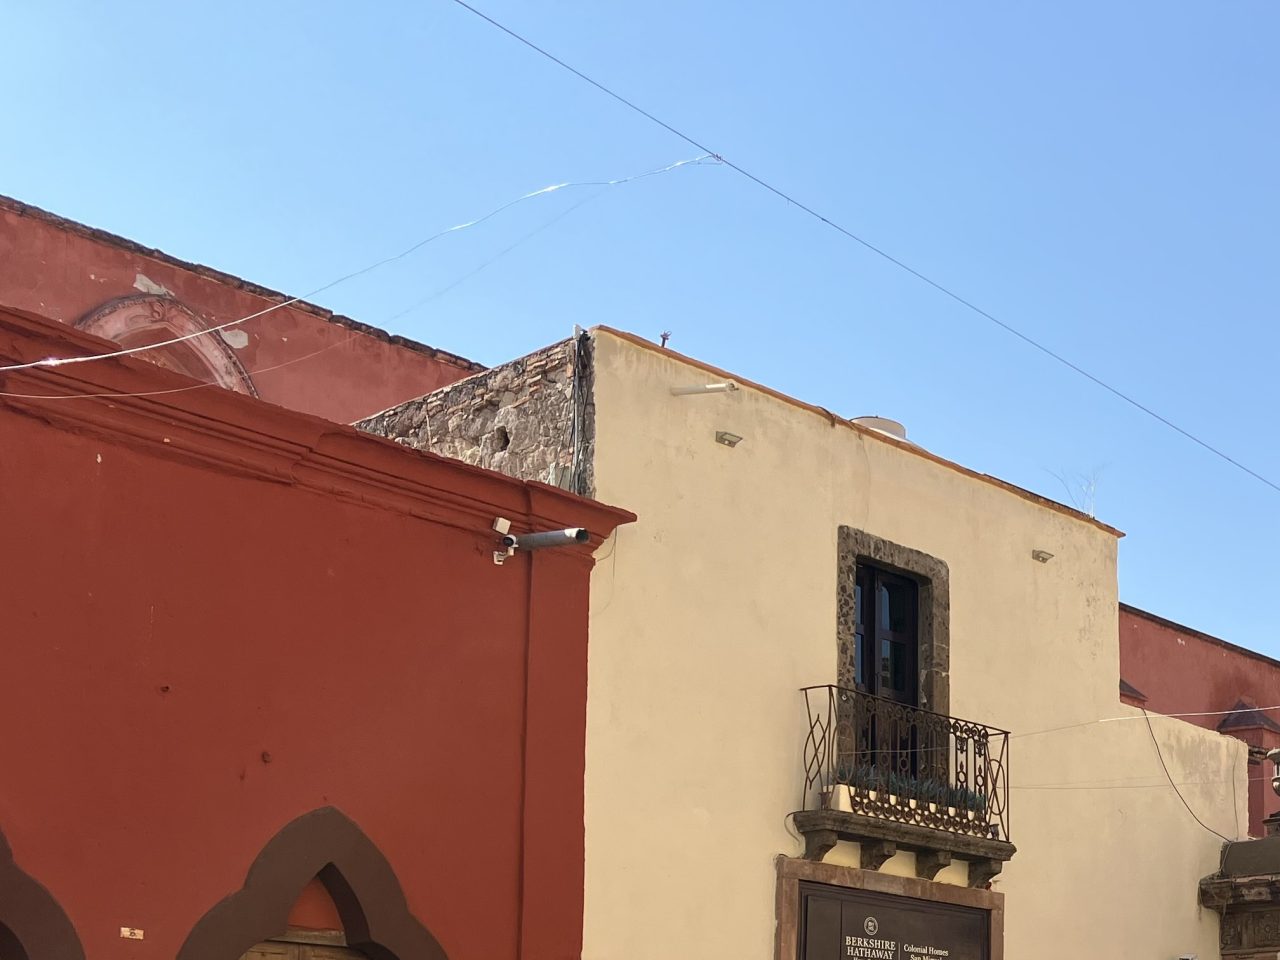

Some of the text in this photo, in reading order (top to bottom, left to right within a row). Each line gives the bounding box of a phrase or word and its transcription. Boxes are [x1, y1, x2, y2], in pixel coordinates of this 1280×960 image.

[845, 936, 896, 950] BERKSHIRE
[847, 946, 894, 960] HATHAWAY
[904, 944, 949, 957] Colonial Homes
